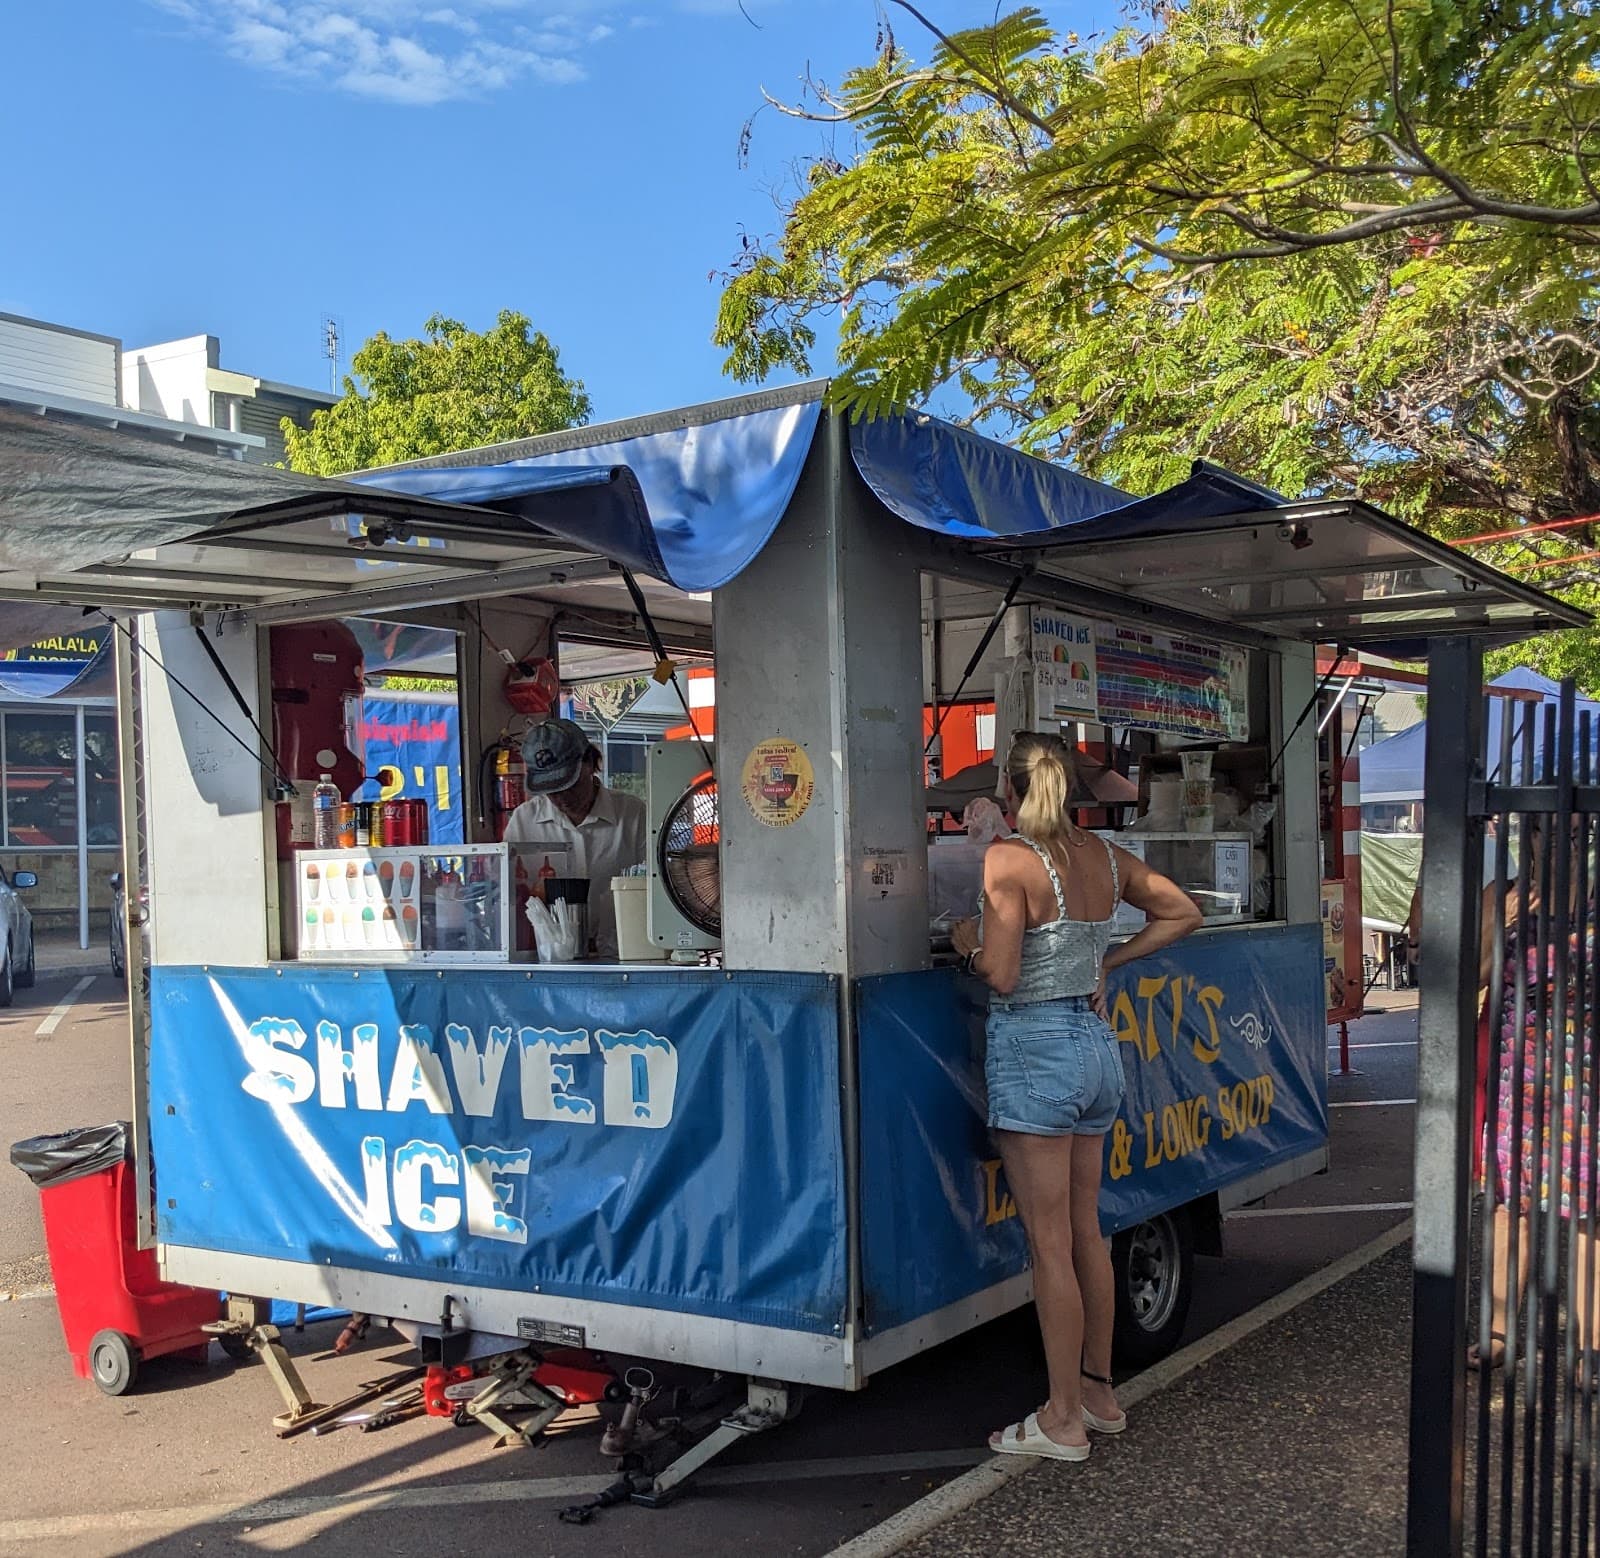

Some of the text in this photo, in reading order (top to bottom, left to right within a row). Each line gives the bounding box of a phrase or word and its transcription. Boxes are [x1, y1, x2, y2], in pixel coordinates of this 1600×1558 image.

[241, 1016, 680, 1129] SHAVED
[1109, 1119, 1133, 1180] &
[1144, 1095, 1212, 1169] LONG
[1218, 1074, 1275, 1141] SOUP
[359, 1136, 533, 1245] ICE
